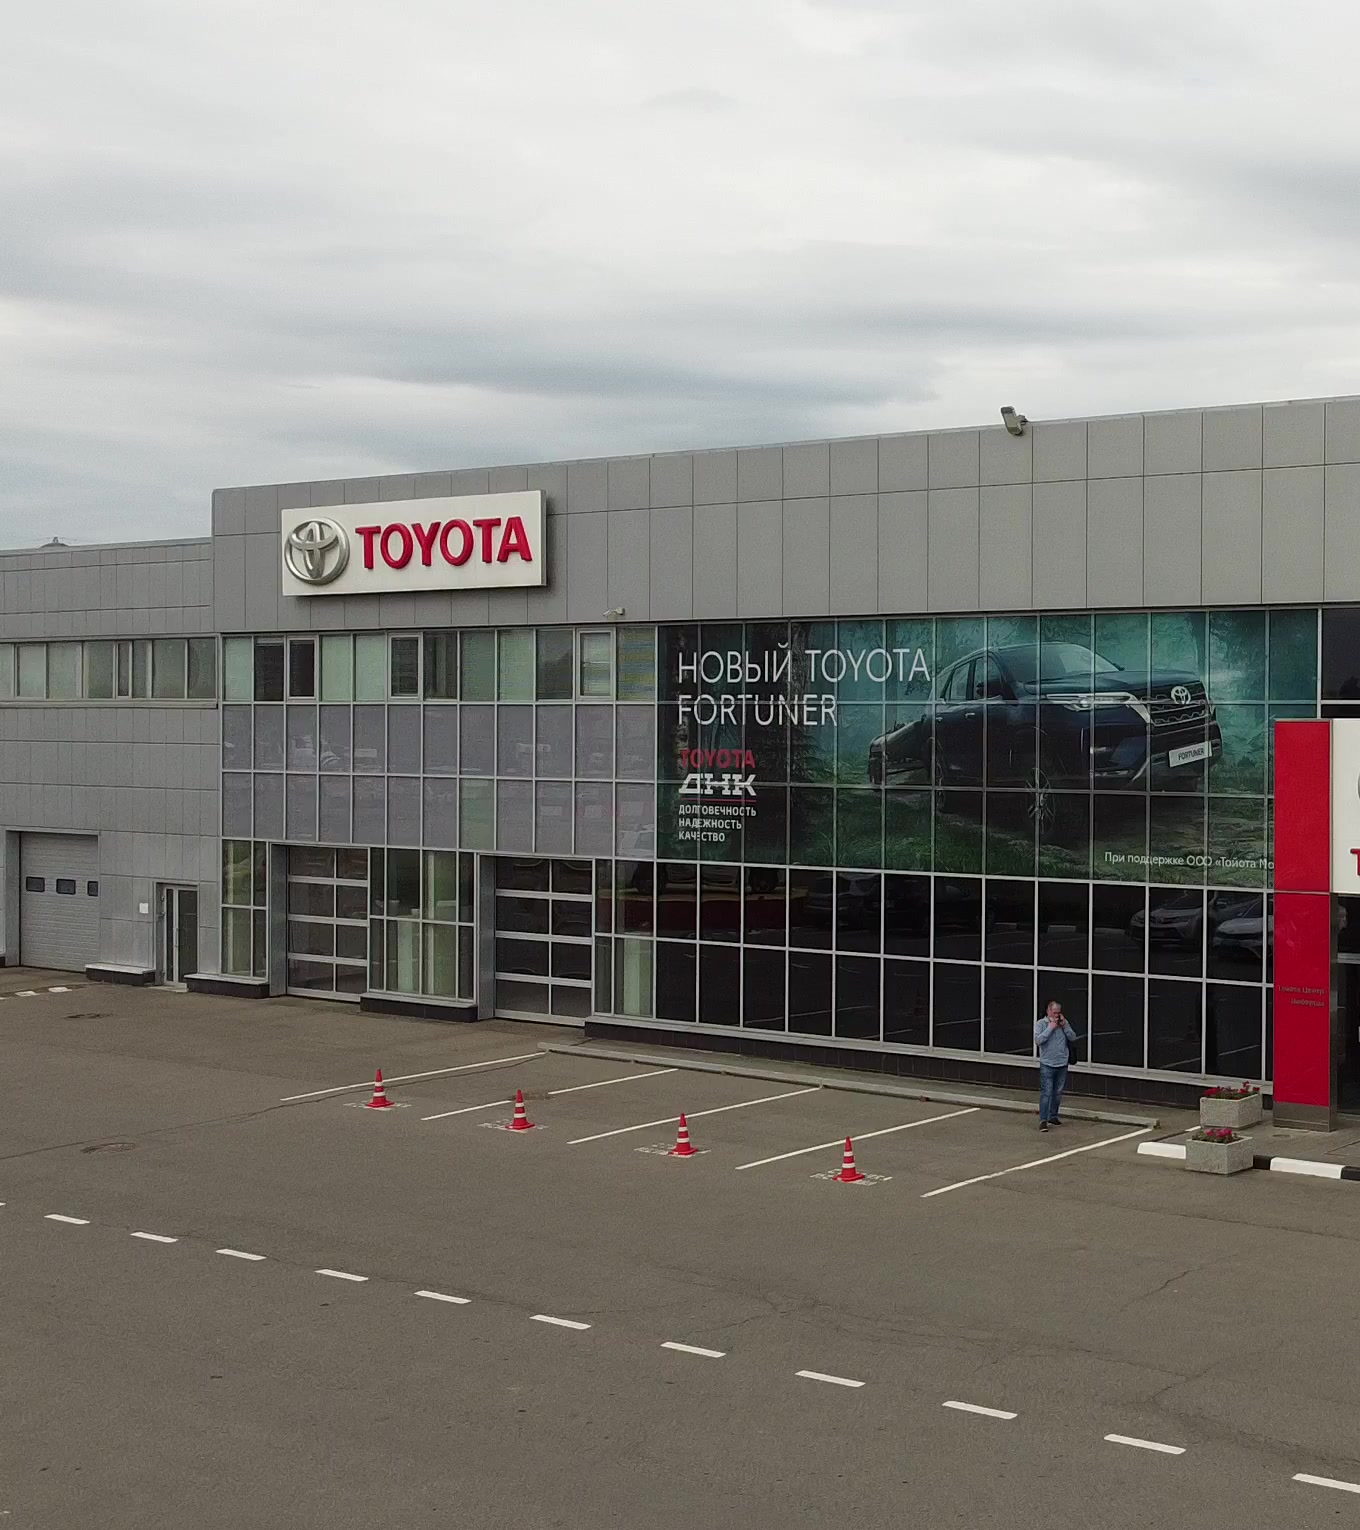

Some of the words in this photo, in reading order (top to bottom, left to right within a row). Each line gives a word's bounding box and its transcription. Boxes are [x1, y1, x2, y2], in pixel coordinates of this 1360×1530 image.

[355, 516, 532, 569] TOYOTA
[678, 642, 792, 684] НОВЫЙ
[805, 648, 930, 682] TOYOTA
[678, 694, 837, 726] FORTUNER
[680, 749, 756, 769] TOYOTA
[679, 773, 756, 796] ДНК
[679, 804, 756, 817] ДОЛГОВЕЧНОСТЬ
[679, 817, 742, 830] НАДЕЖНОСТЬ
[679, 830, 725, 842] КАЧЕСТВО
[1105, 851, 1124, 864] При
[1128, 854, 1184, 867] поддержке
[1187, 856, 1212, 867] ООО
[1216, 856, 1256, 869] «Тойота
